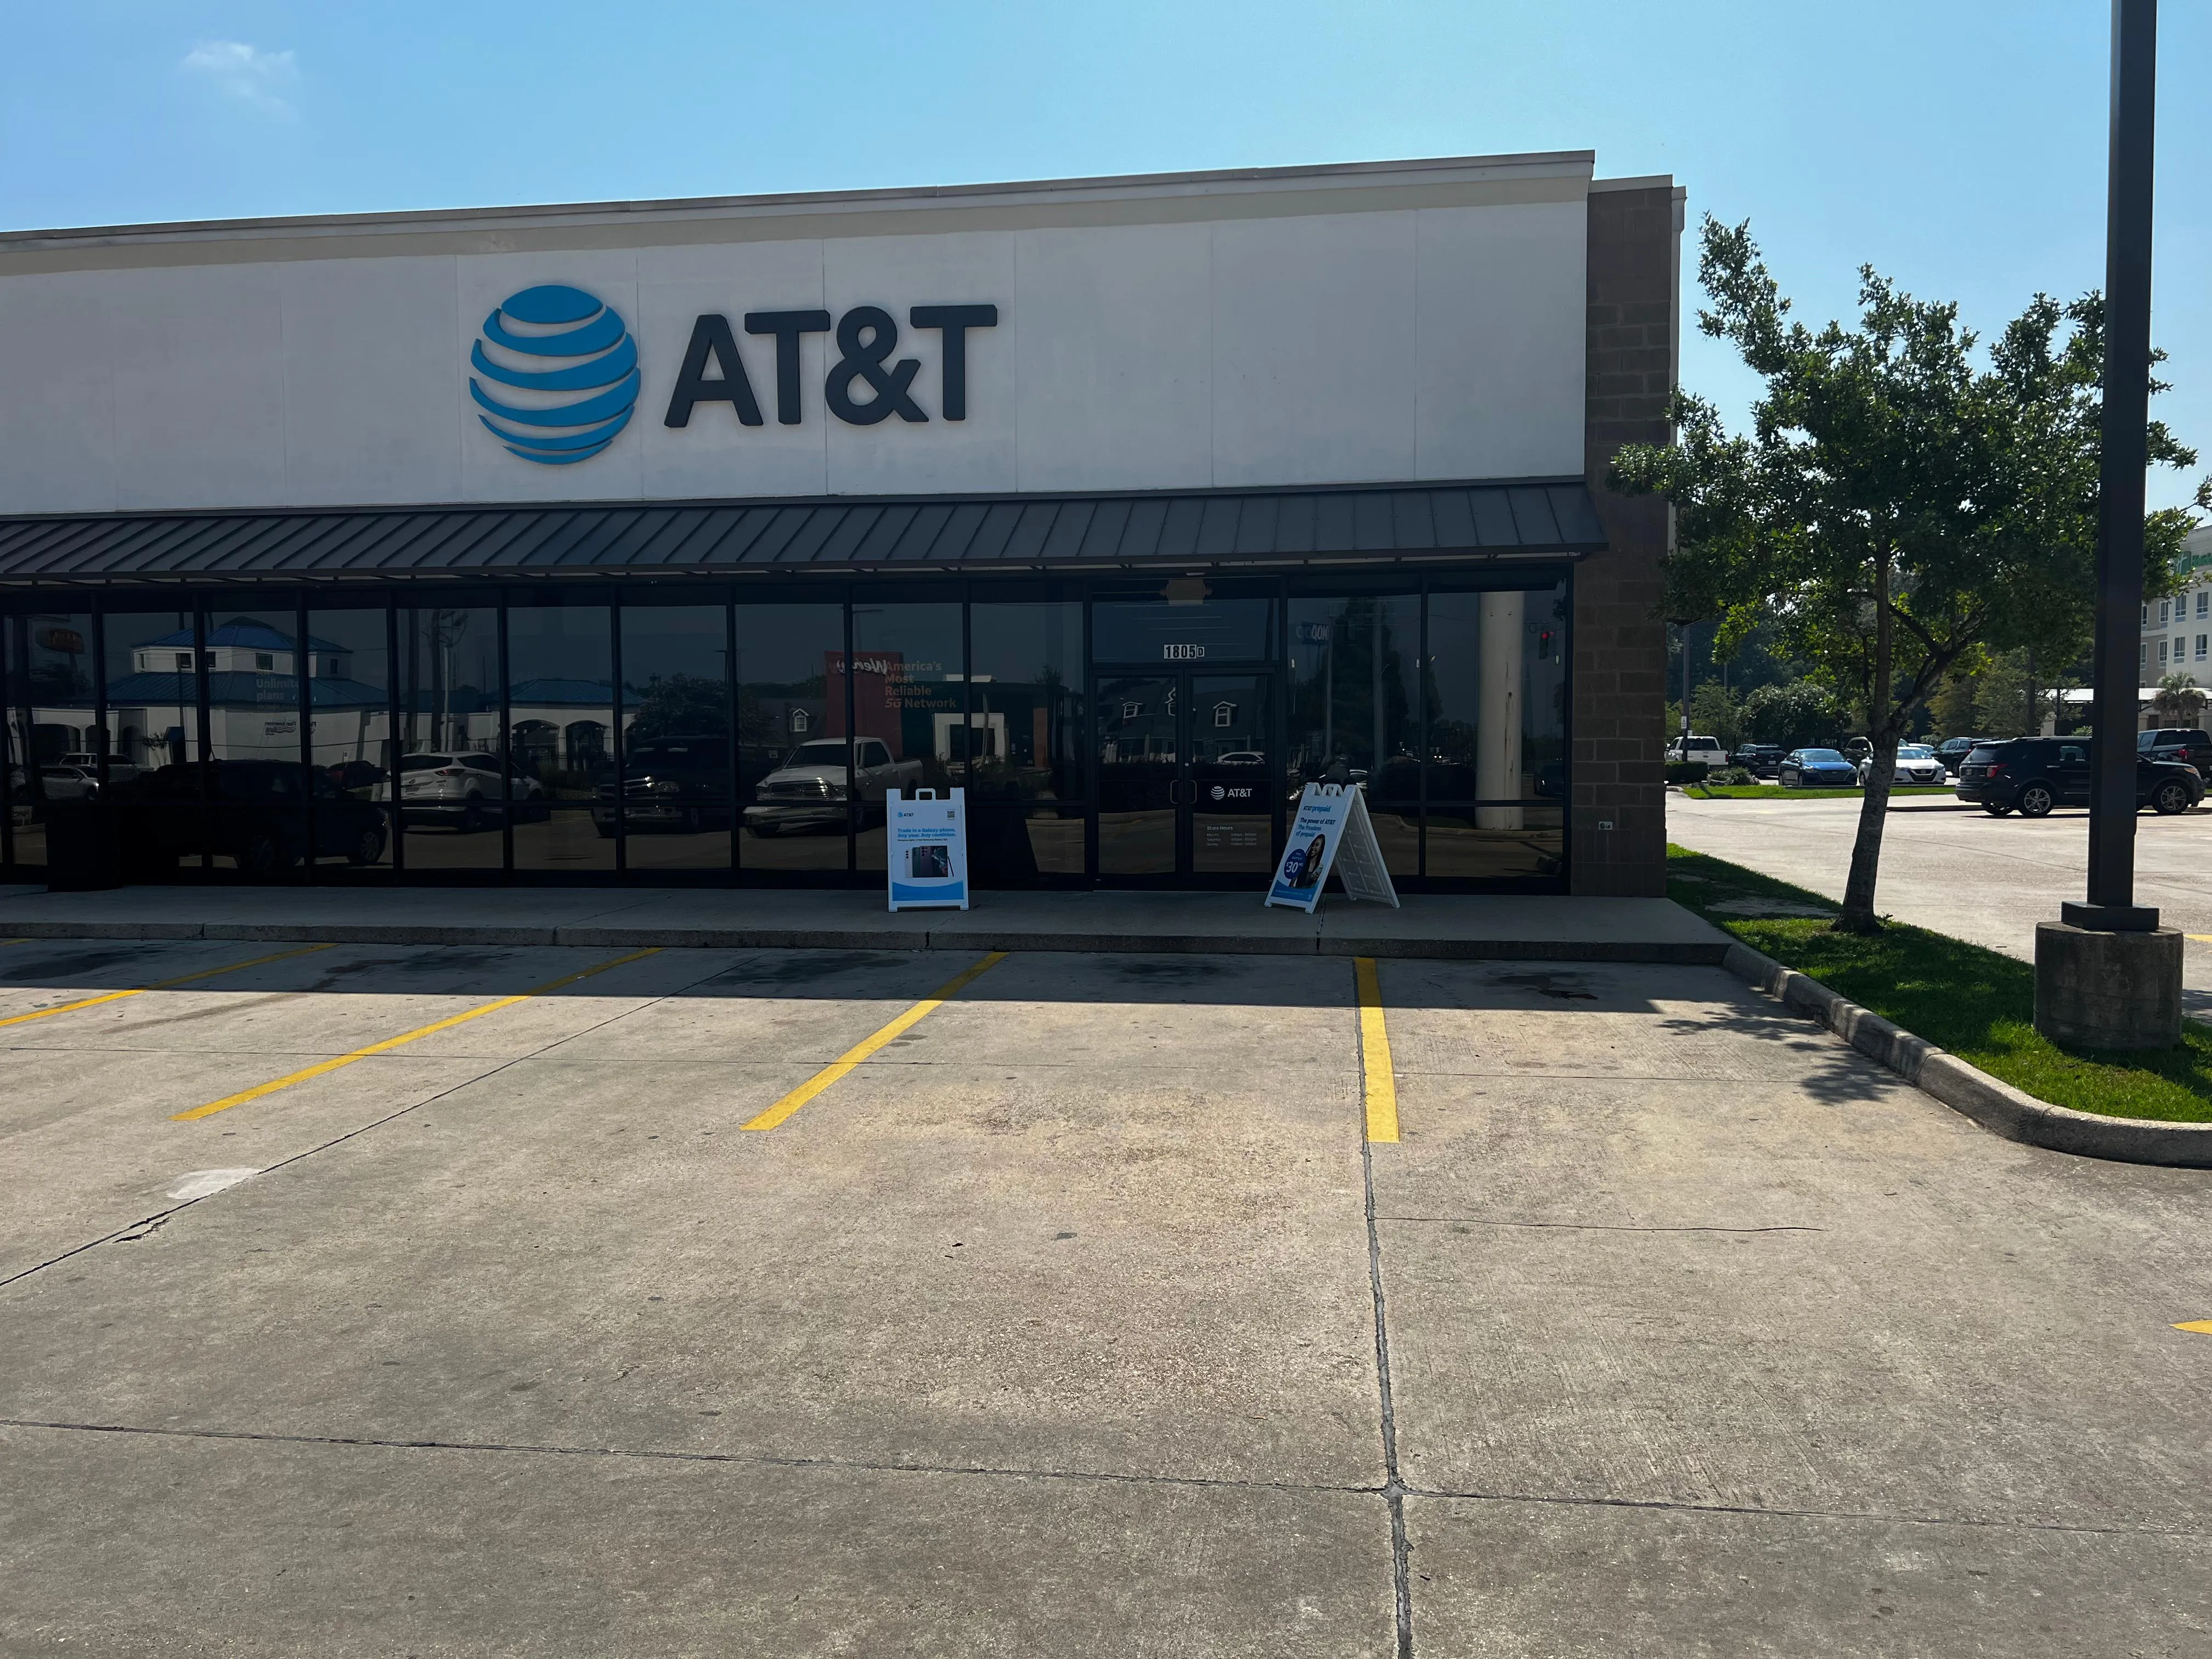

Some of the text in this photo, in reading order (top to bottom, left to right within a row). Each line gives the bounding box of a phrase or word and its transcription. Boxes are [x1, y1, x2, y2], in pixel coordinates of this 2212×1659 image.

[664, 304, 997, 428] AT&T
[886, 661, 942, 672] America's
[885, 674, 915, 684] Most
[257, 690, 285, 702] plans
[885, 686, 932, 696] Reliable
[885, 697, 957, 708] 5G Network
[1227, 788, 1252, 797] AT&T
[1285, 861, 1299, 873] $30
